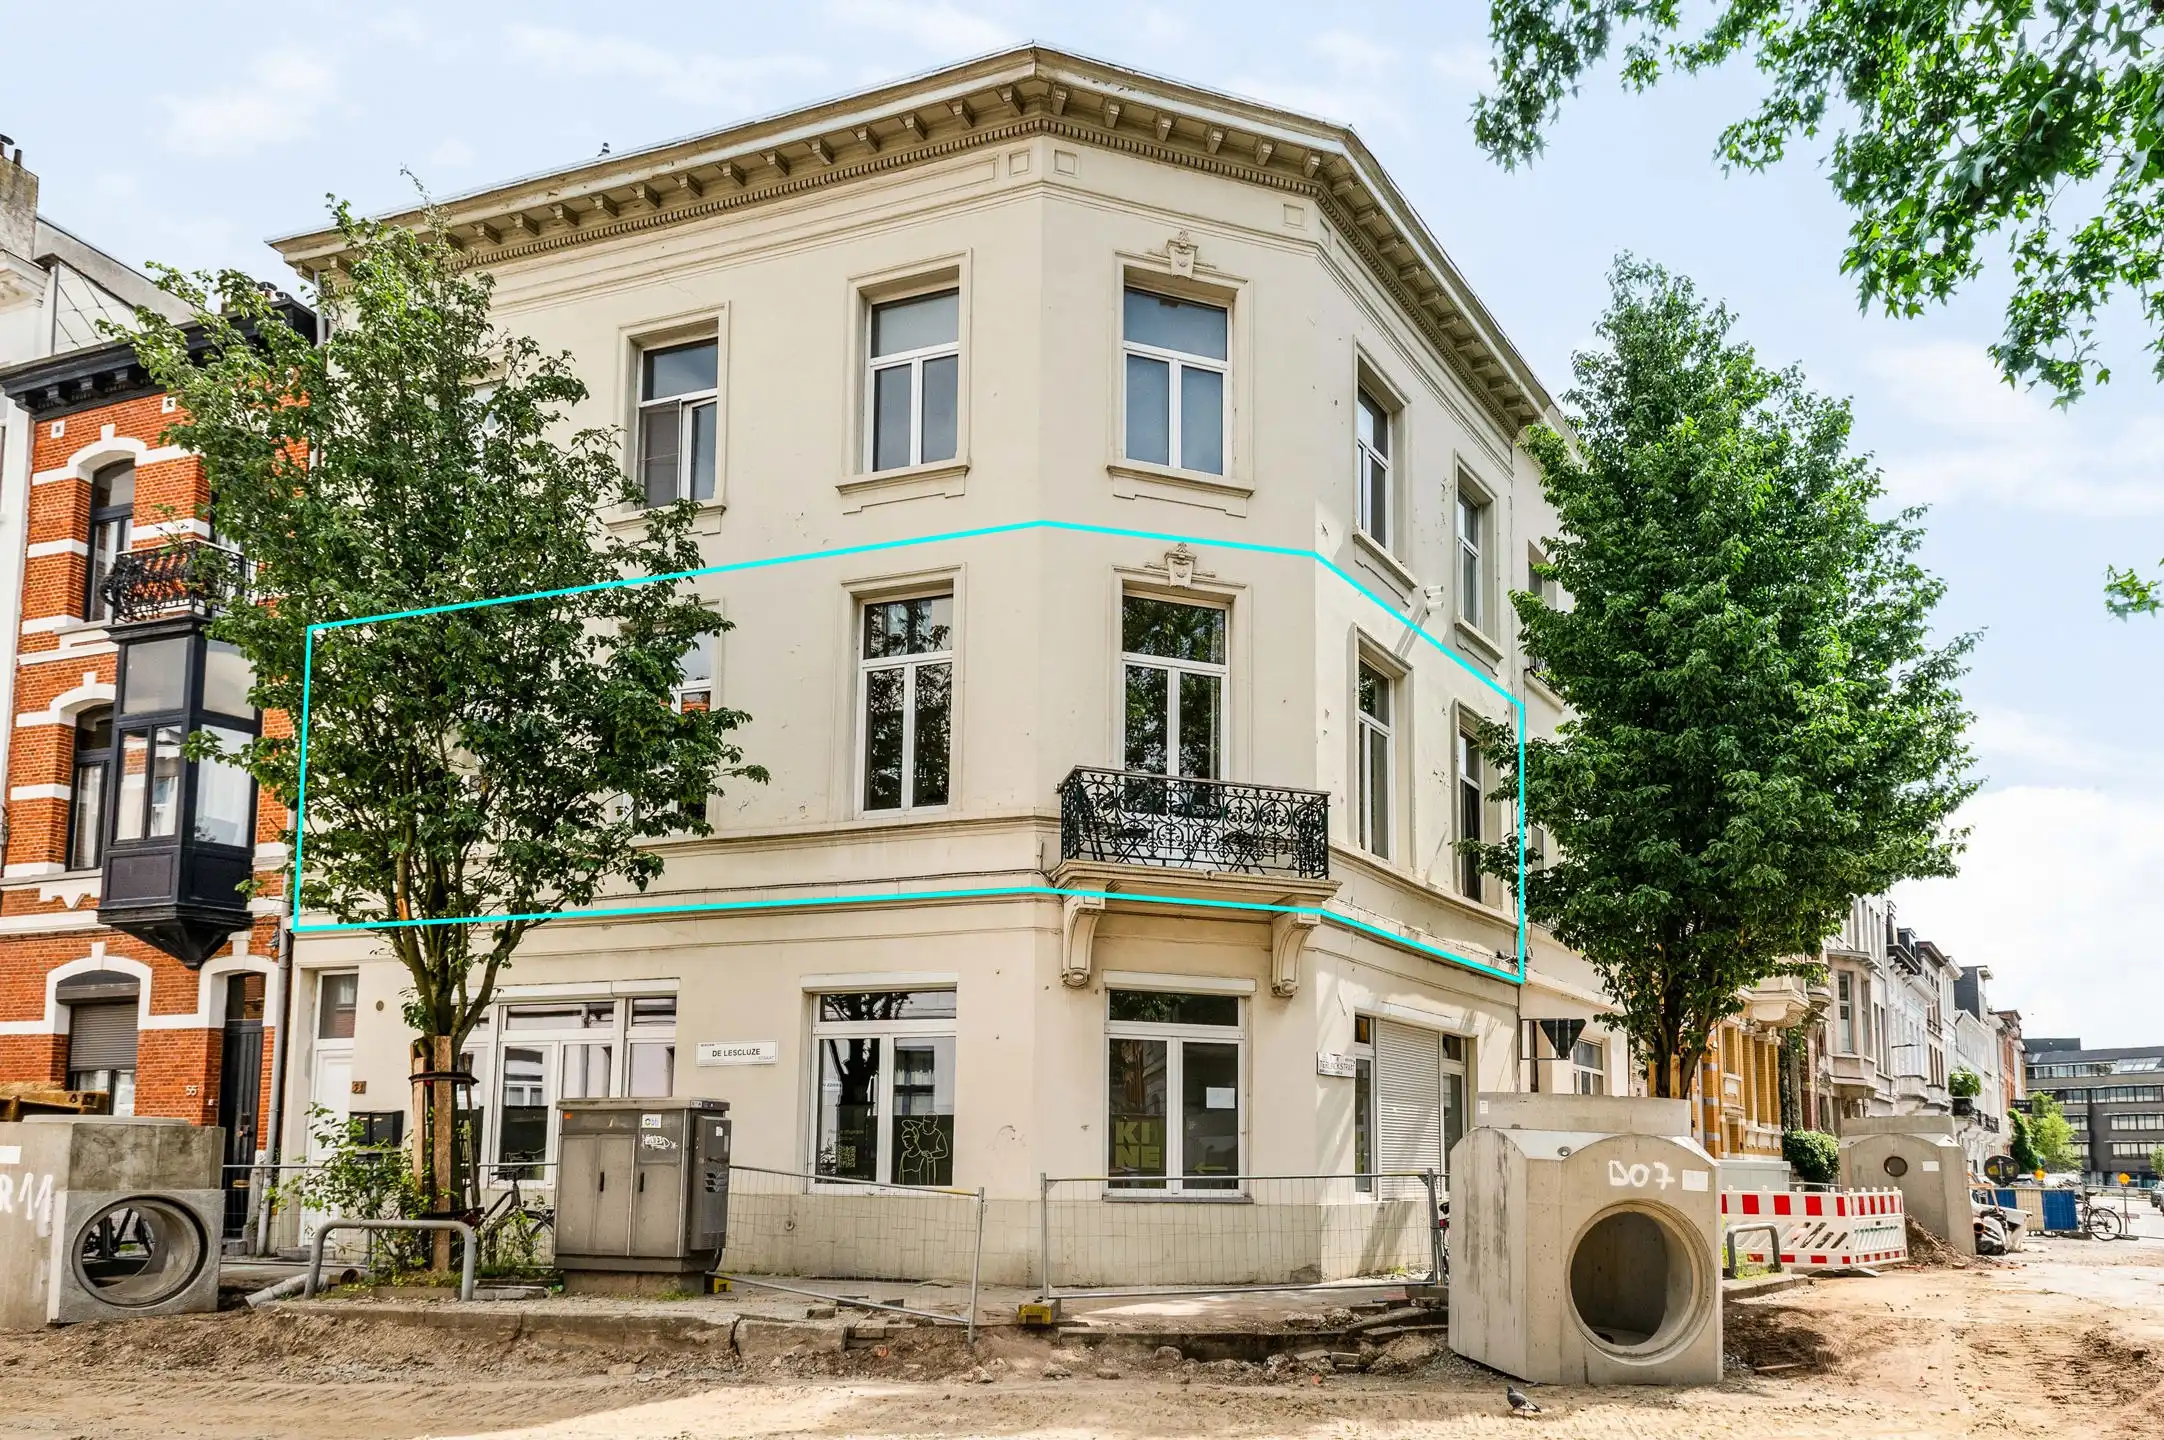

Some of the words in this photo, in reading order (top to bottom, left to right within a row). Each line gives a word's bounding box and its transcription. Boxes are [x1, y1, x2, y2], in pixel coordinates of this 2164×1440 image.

[712, 1049, 722, 1057] DE
[723, 1048, 761, 1057] LESCLUZE
[185, 1085, 198, 1096] 55
